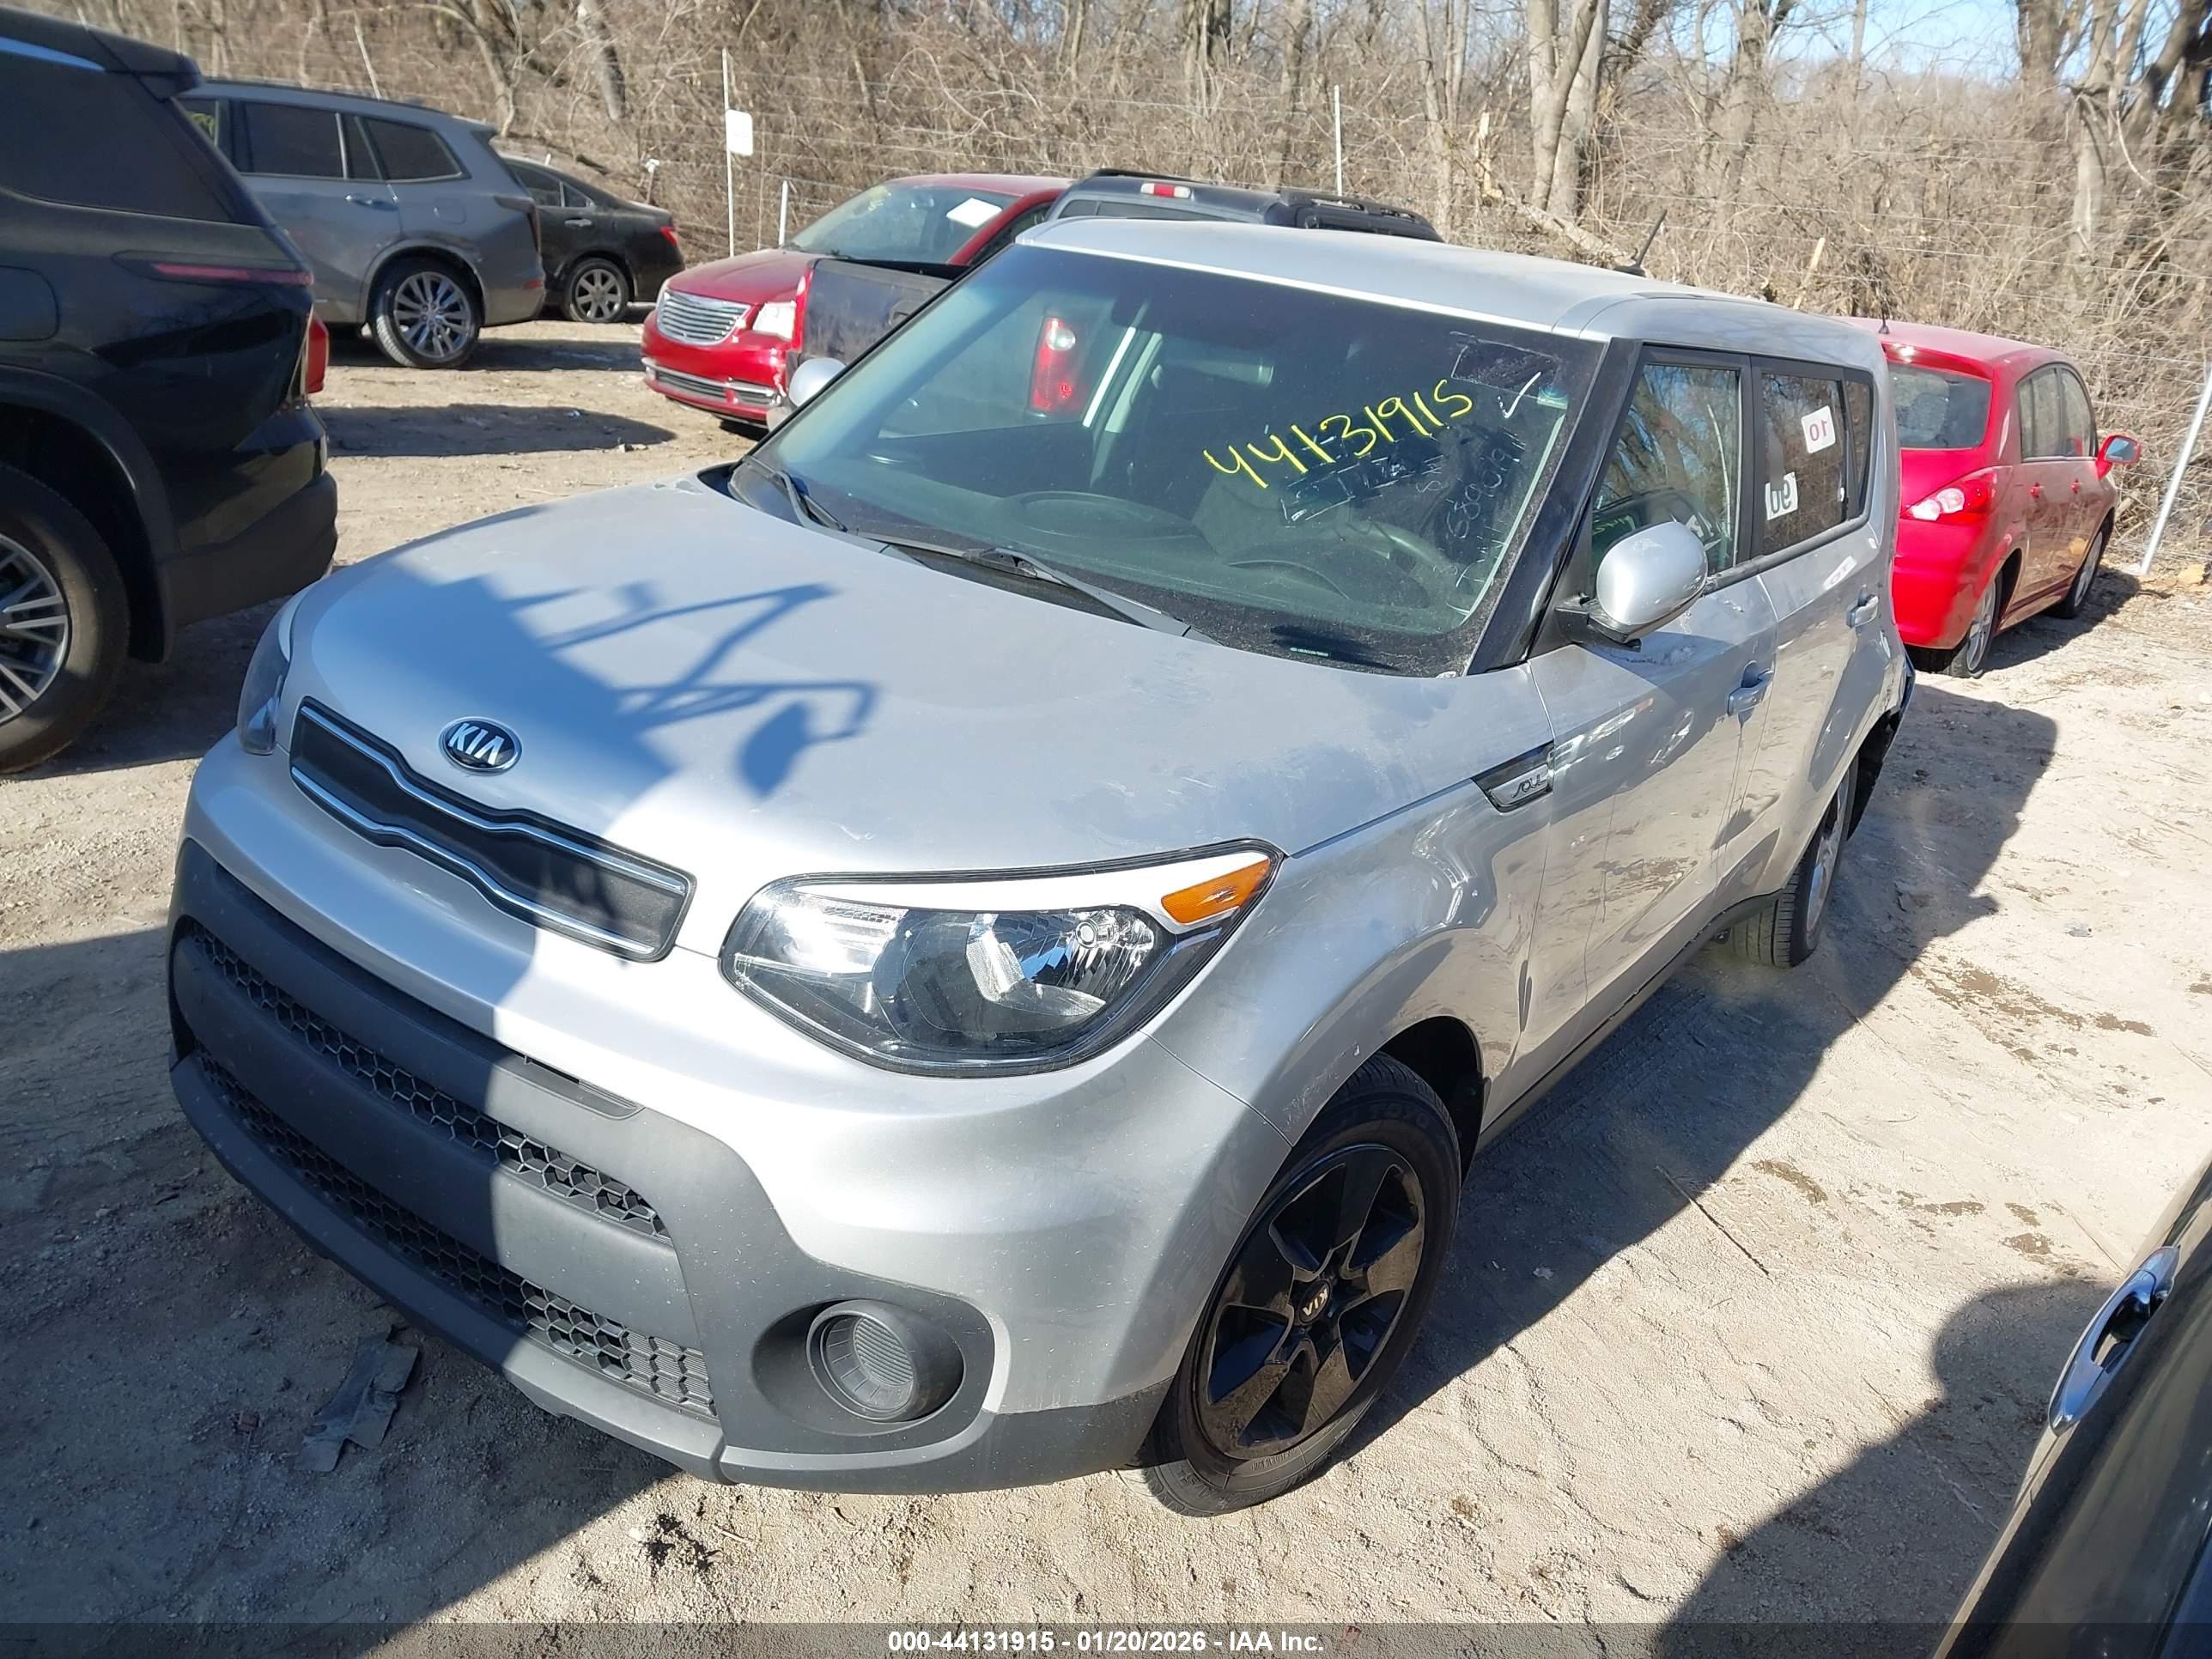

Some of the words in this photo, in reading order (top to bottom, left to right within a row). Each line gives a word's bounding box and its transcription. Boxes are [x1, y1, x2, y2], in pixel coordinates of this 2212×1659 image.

[1204, 379, 1474, 489] 44131915
[447, 722, 505, 765] KIA
[1302, 1287, 1328, 1316] KIA
